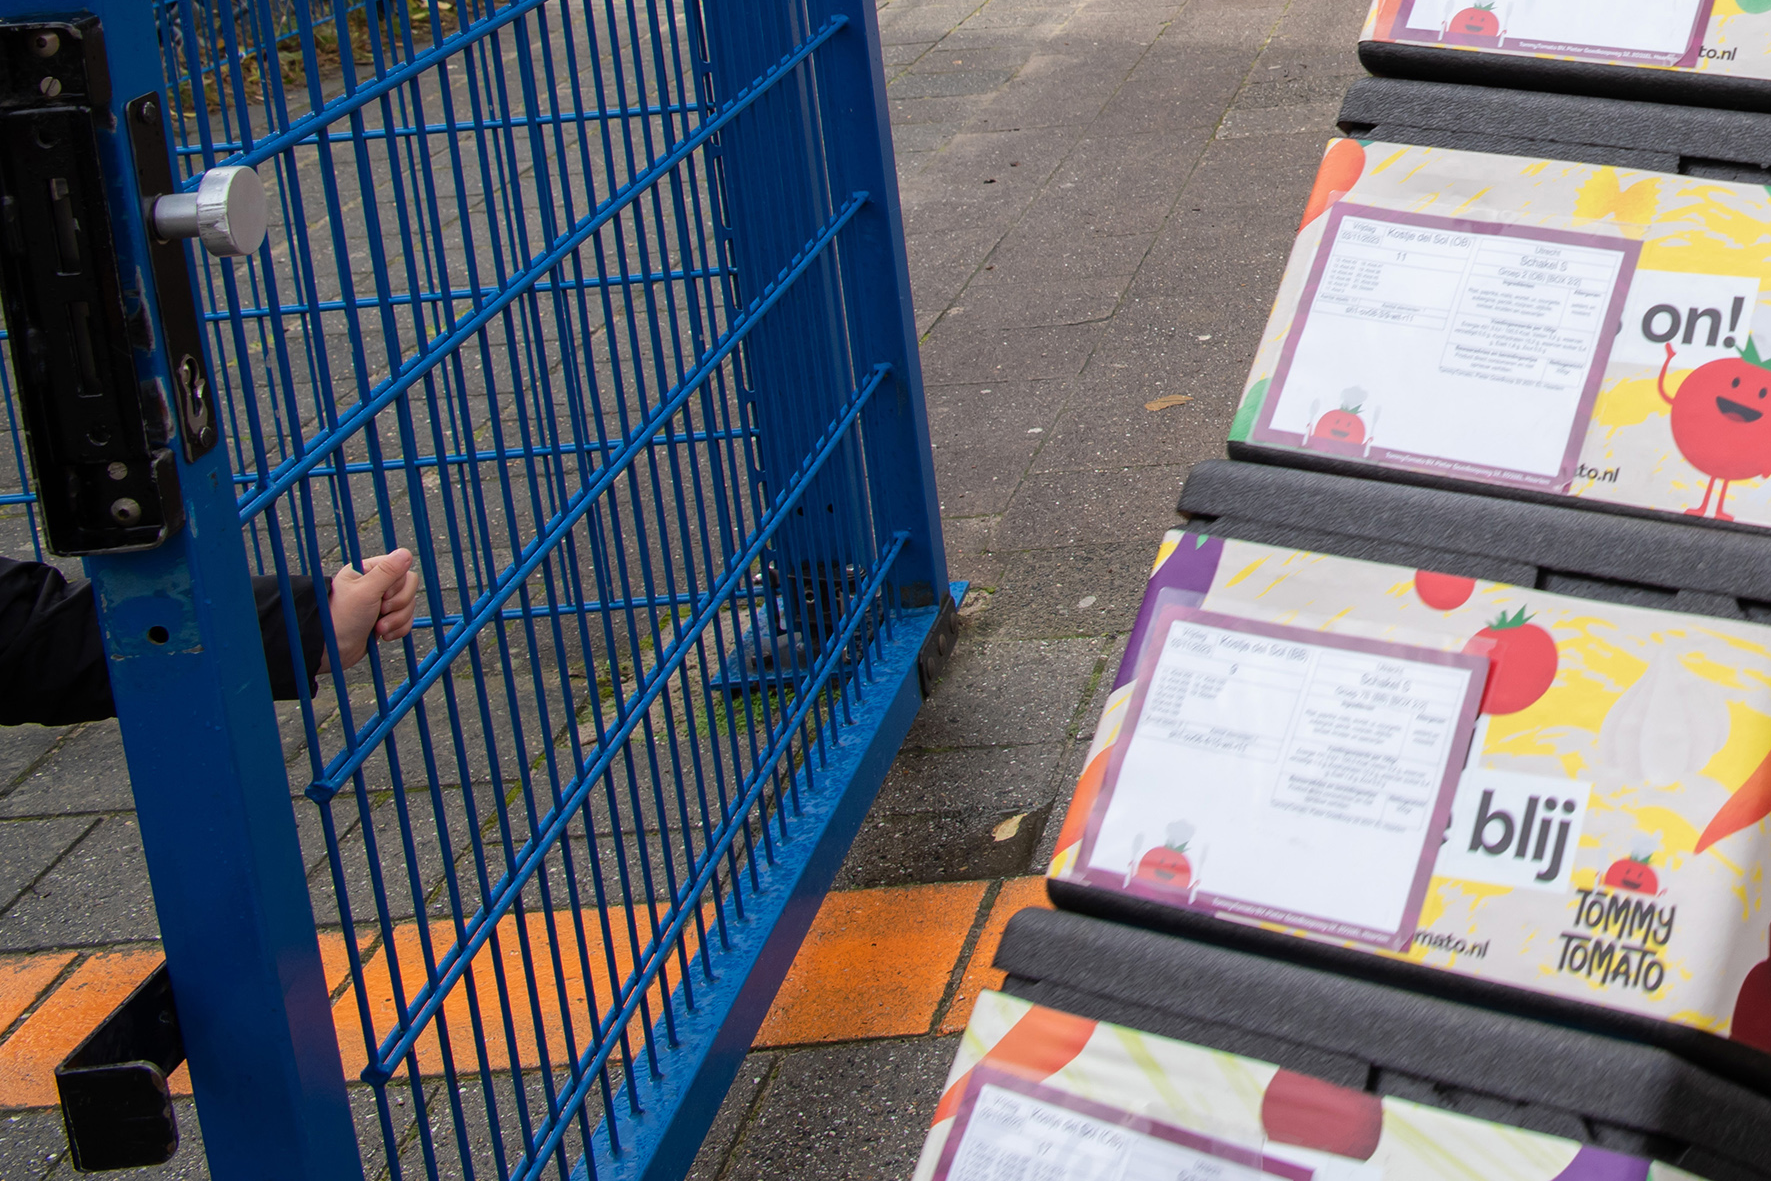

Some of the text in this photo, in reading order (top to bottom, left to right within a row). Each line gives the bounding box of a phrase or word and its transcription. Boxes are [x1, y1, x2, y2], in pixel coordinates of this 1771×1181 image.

[1396, 251, 1407, 261] 11
[1641, 296, 1745, 348] on!
[1574, 463, 1621, 483] to.nl
[1467, 788, 1577, 884] blij
[1573, 889, 1676, 946] TOMMY
[1556, 931, 1665, 992] TOMATO
